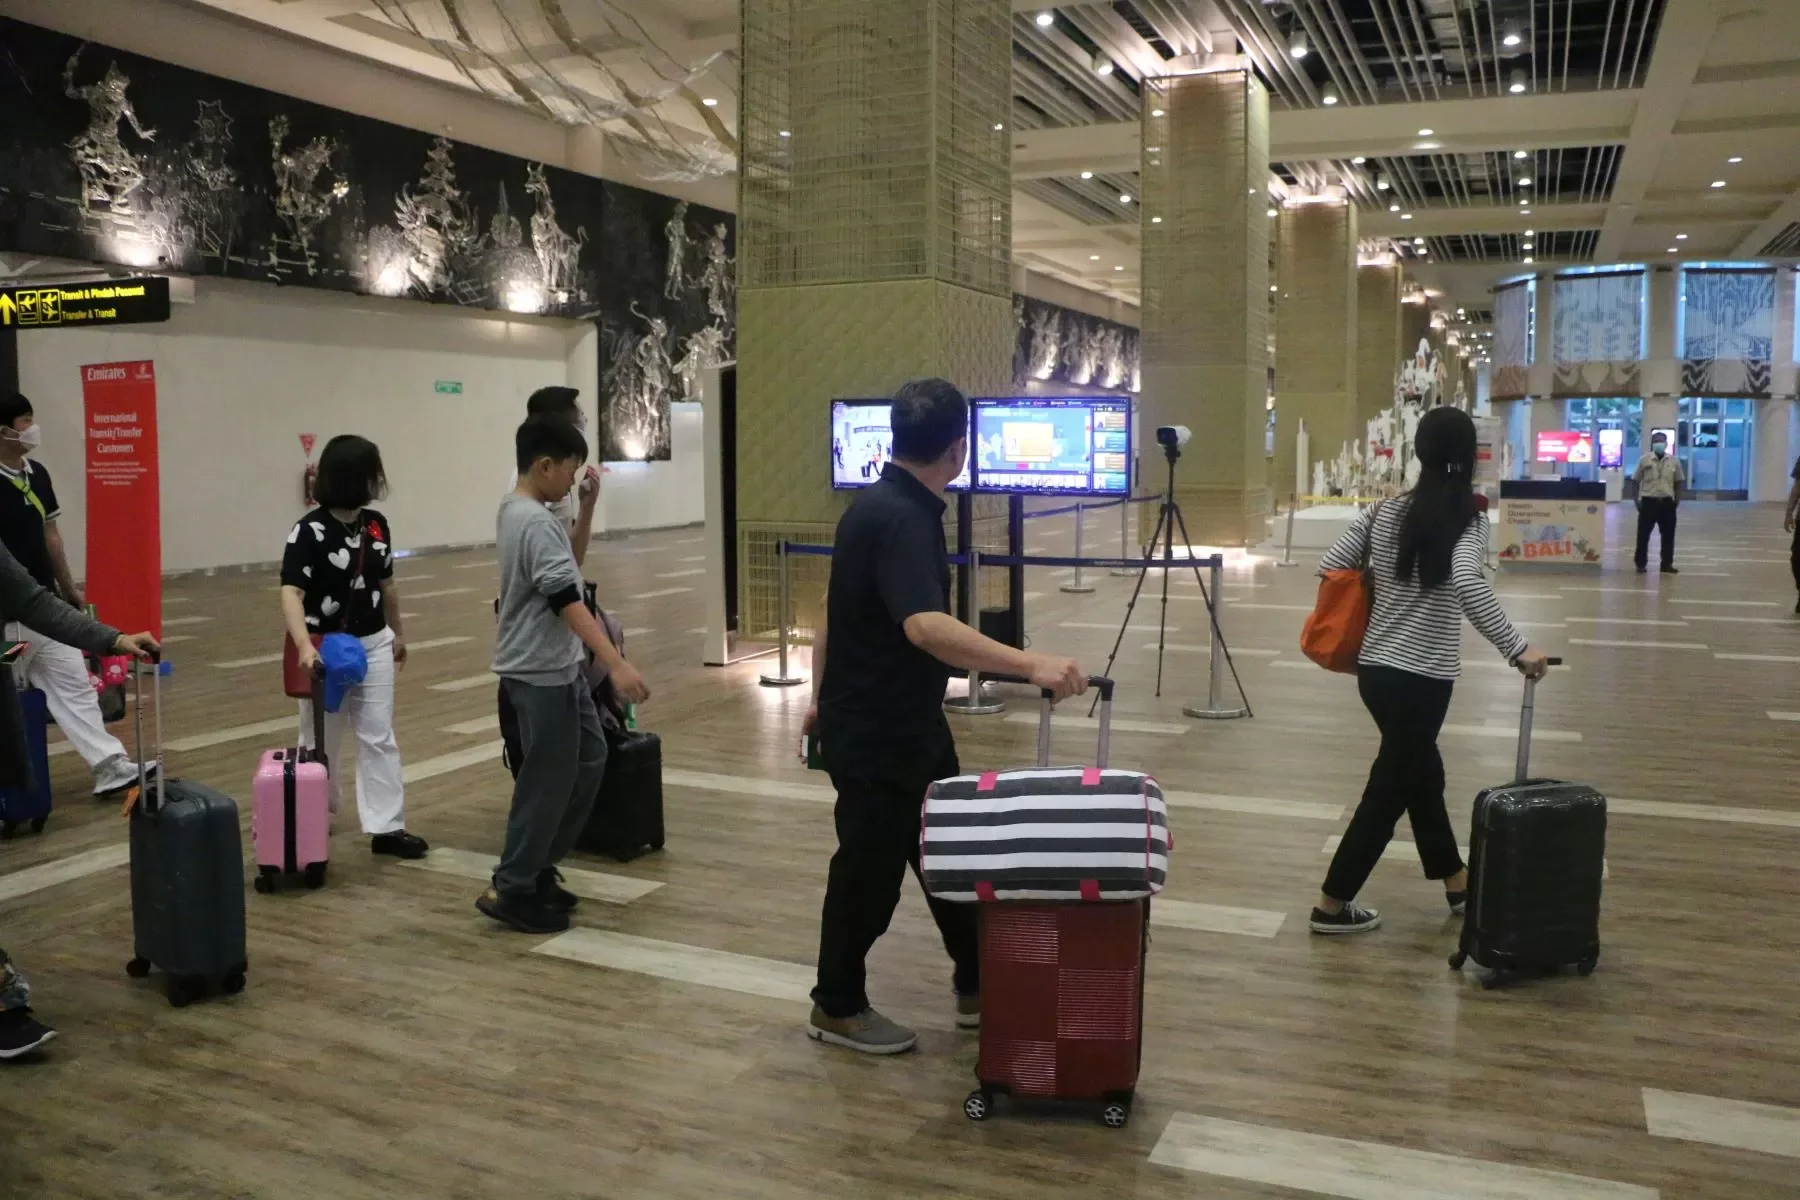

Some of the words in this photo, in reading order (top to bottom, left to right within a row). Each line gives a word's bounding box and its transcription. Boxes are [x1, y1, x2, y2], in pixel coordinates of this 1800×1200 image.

[87, 367, 126, 381] Emirates
[93, 411, 137, 423] International
[97, 442, 134, 454] Customers
[1523, 541, 1572, 559] BALI
